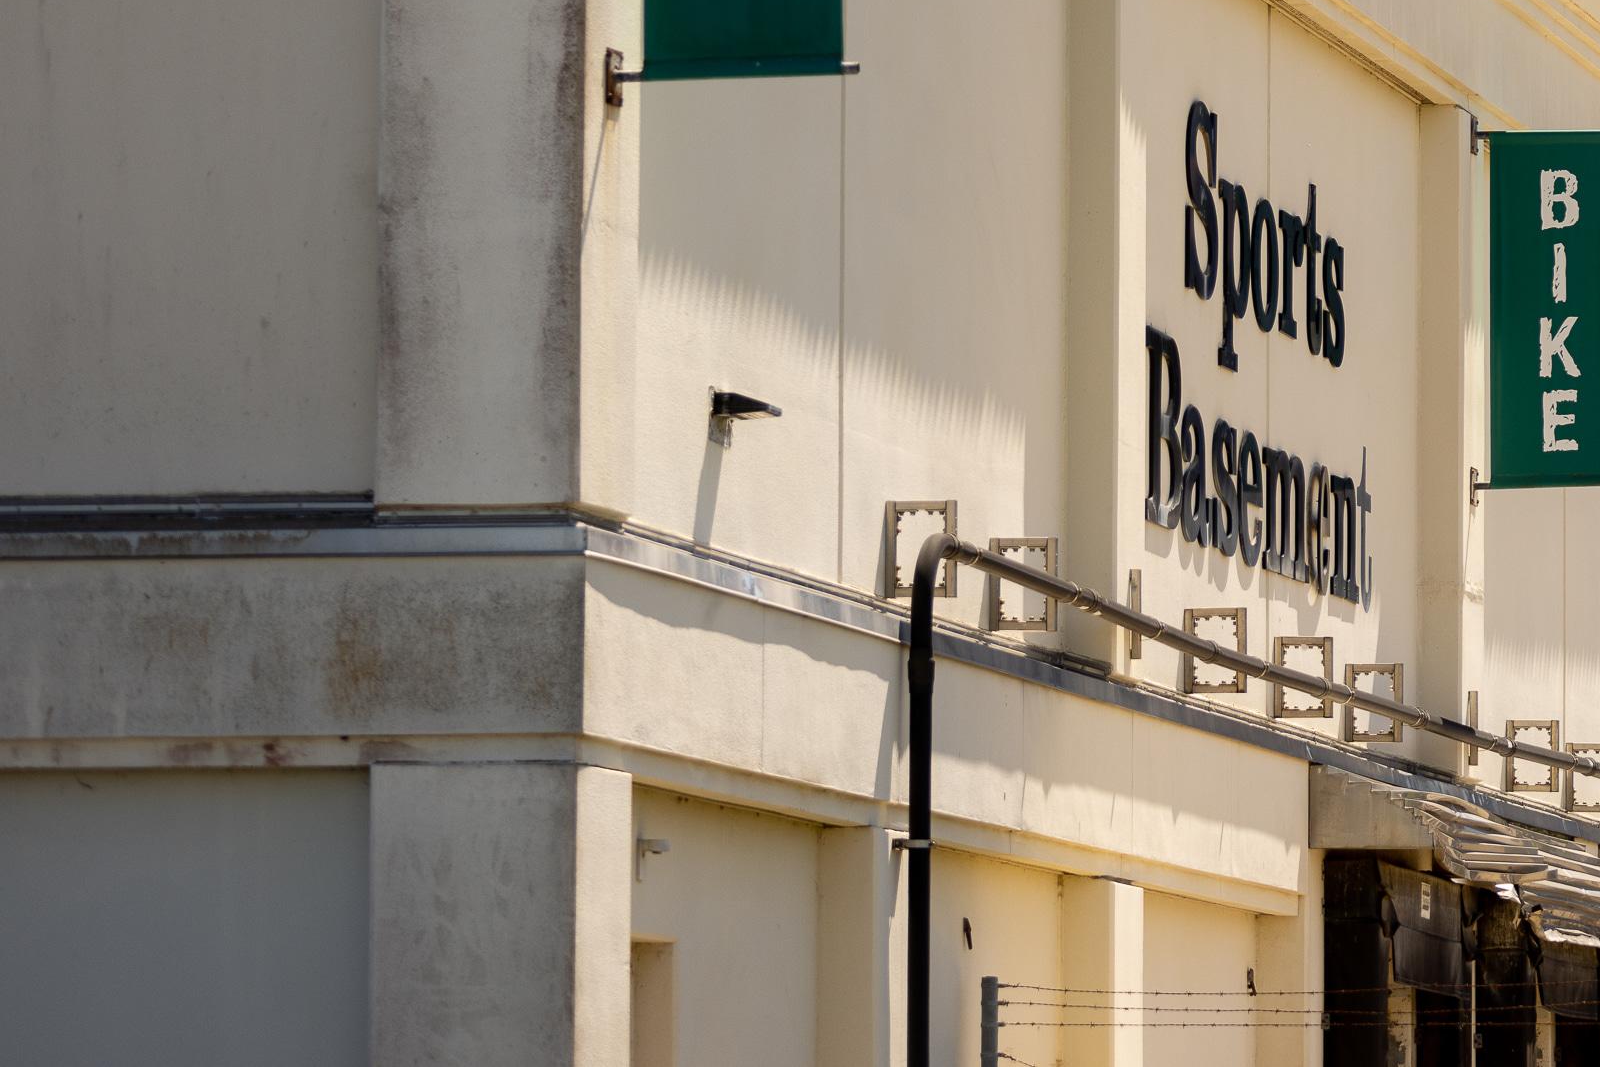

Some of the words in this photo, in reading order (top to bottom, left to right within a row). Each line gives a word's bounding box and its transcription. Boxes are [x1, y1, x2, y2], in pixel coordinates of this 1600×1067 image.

[1184, 100, 1346, 373] Sports
[1539, 169, 1581, 452] BIKE
[1145, 325, 1373, 613] Basement
